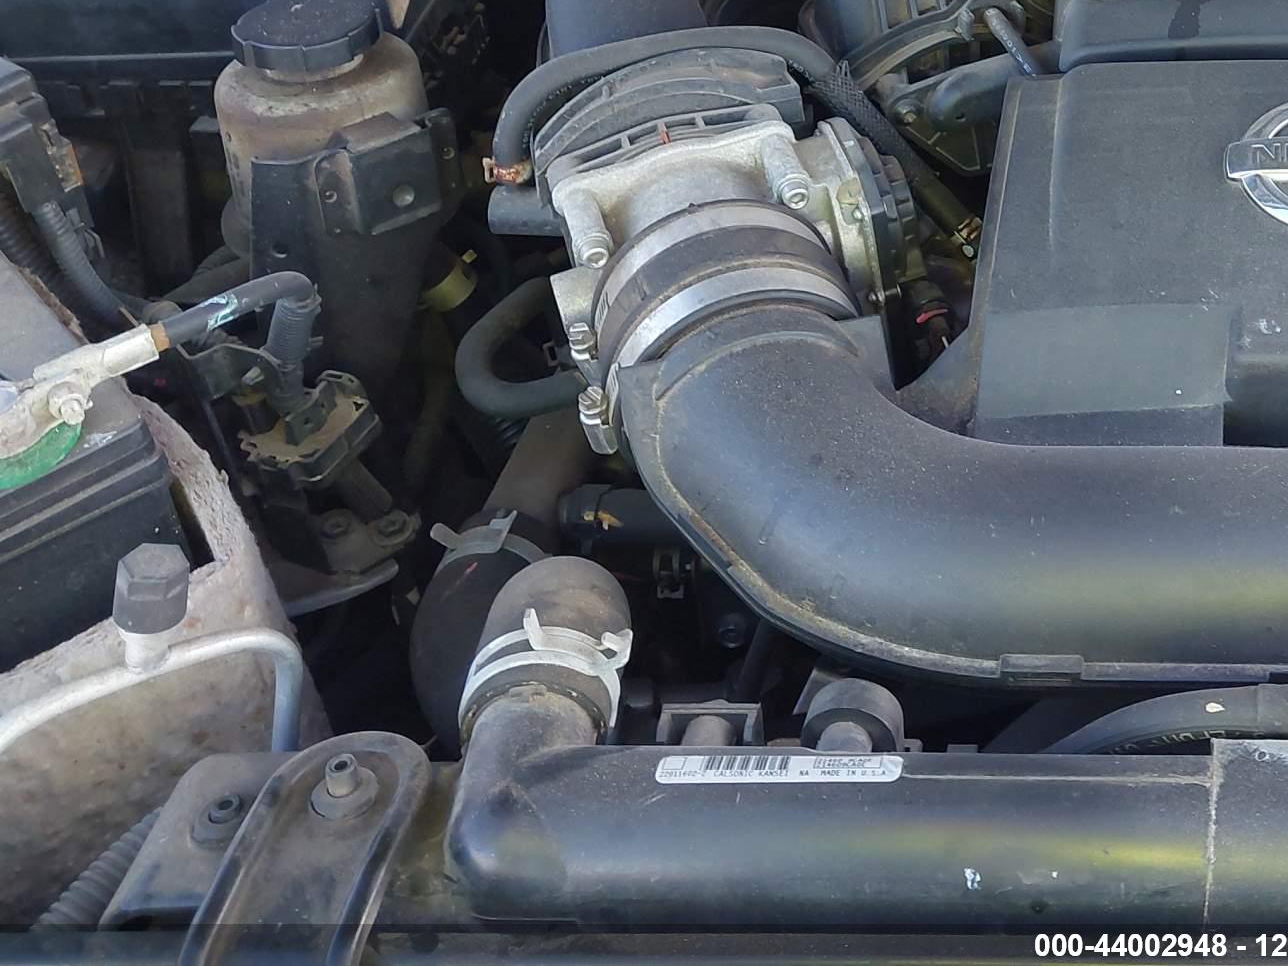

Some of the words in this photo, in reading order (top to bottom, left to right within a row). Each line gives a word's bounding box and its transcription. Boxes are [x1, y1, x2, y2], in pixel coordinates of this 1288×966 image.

[713, 769, 754, 778] CALSONIC
[758, 769, 789, 777] KANSEI
[798, 769, 809, 777] NA
[820, 769, 841, 777] MADE
[846, 769, 857, 777] IN
